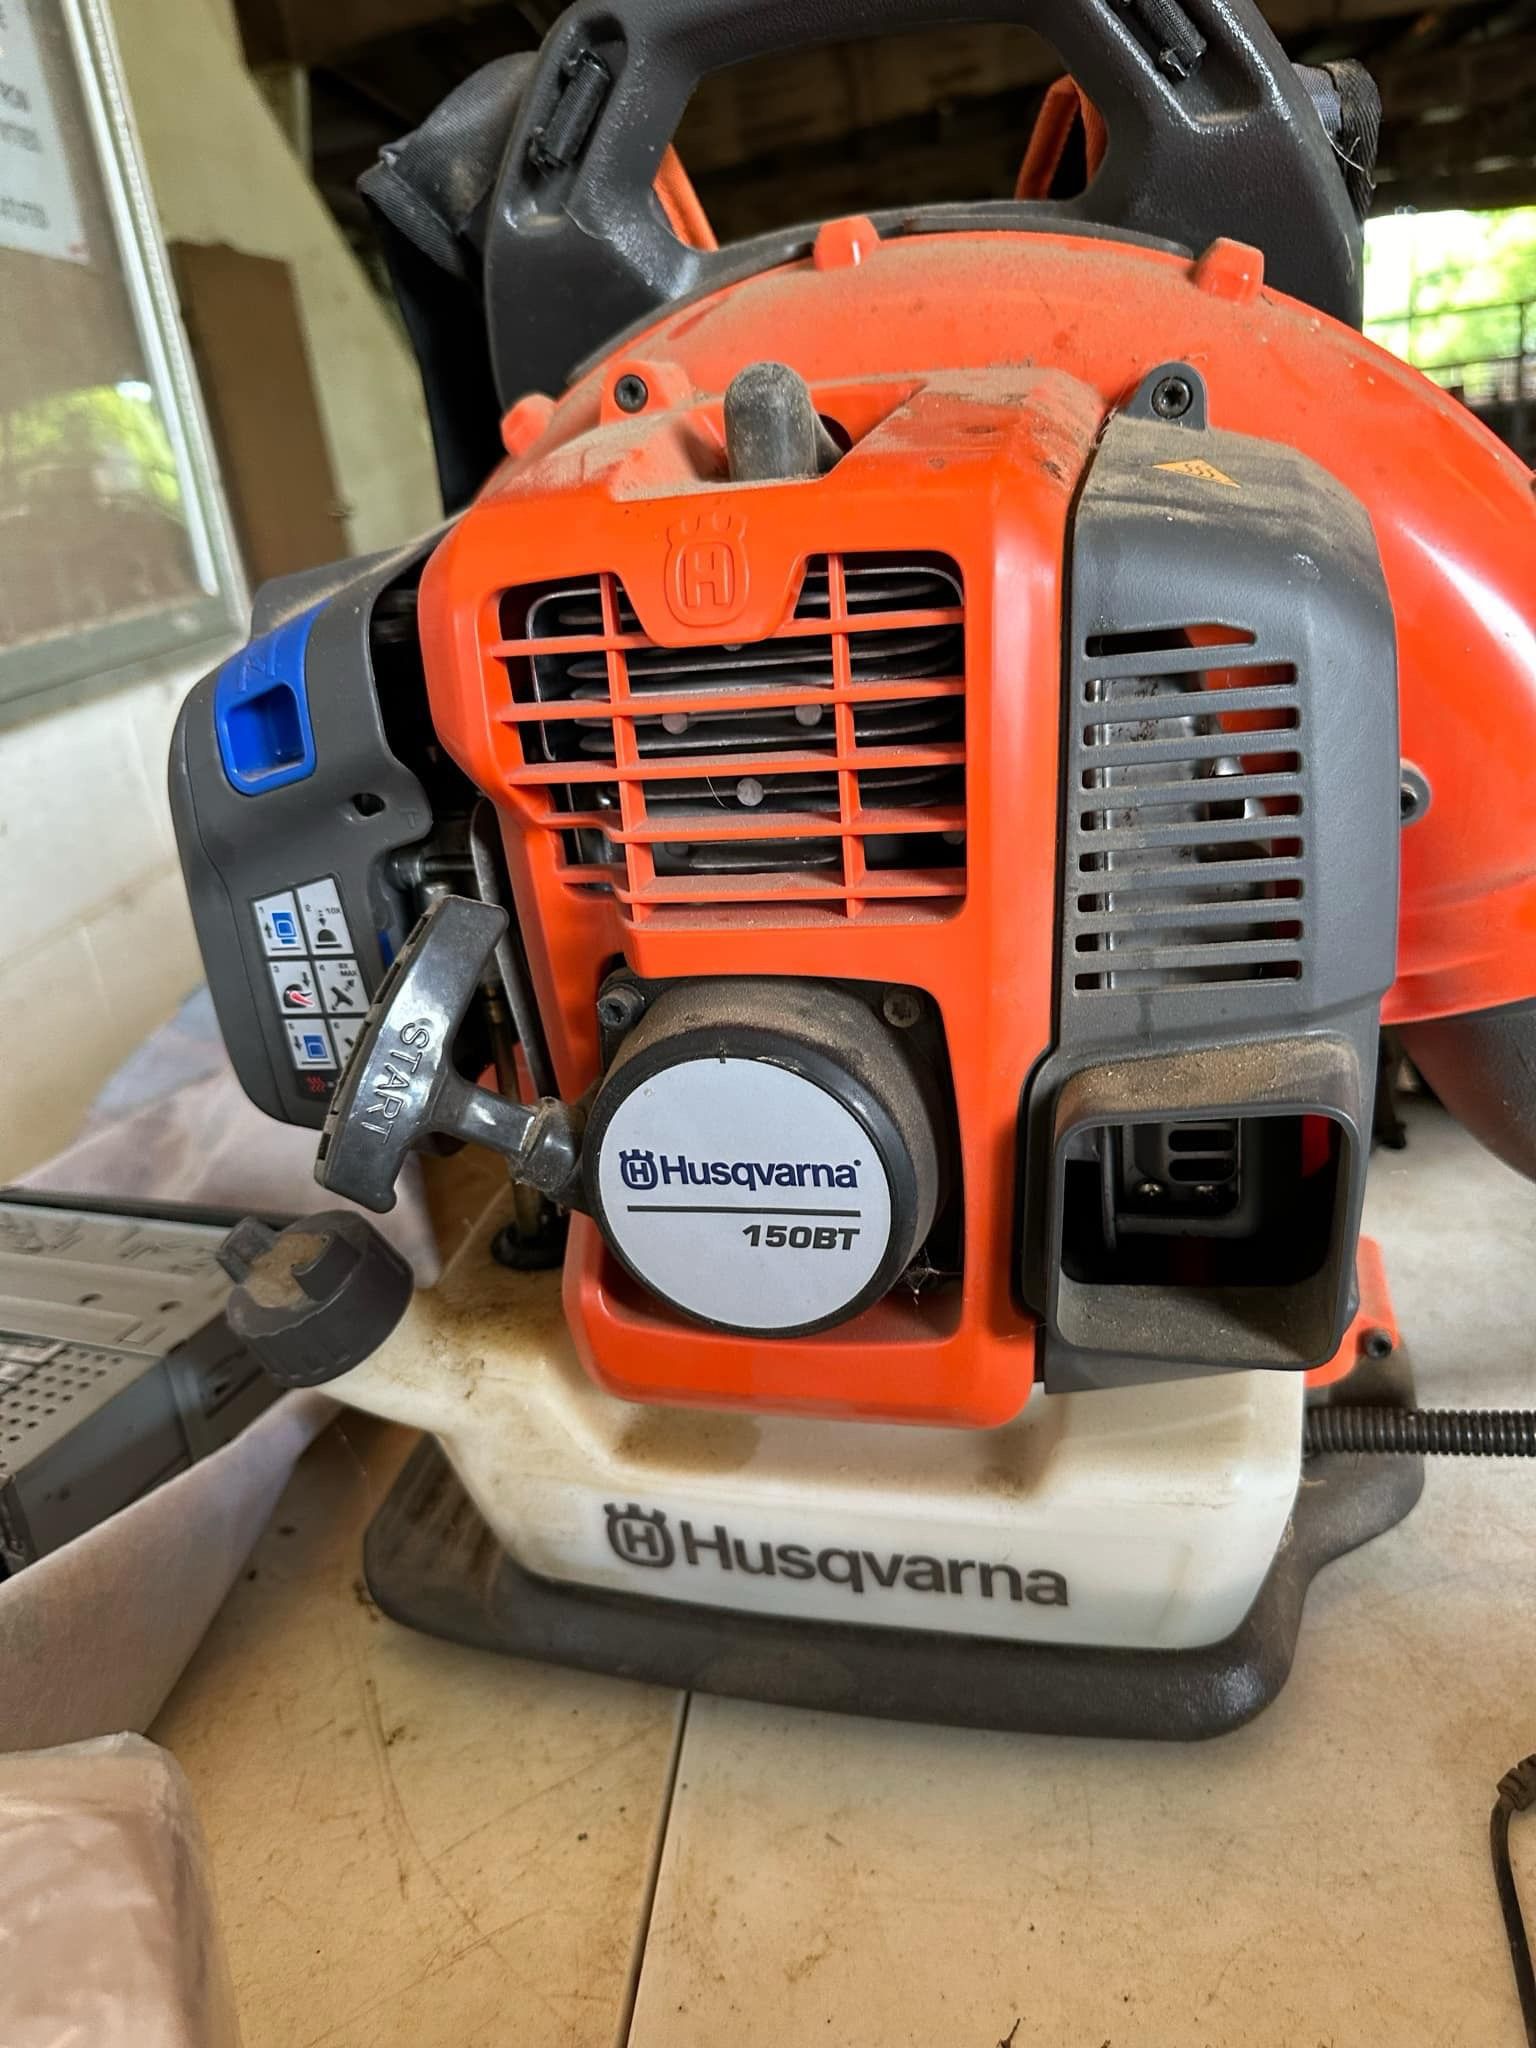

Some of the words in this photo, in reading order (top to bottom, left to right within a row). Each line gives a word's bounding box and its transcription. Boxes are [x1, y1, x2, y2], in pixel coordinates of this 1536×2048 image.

[361, 1022, 430, 1144] START
[660, 1155, 858, 1191] Husqvarna
[742, 1224, 860, 1250] 150BT
[680, 1520, 1069, 1607] Husqvarna
